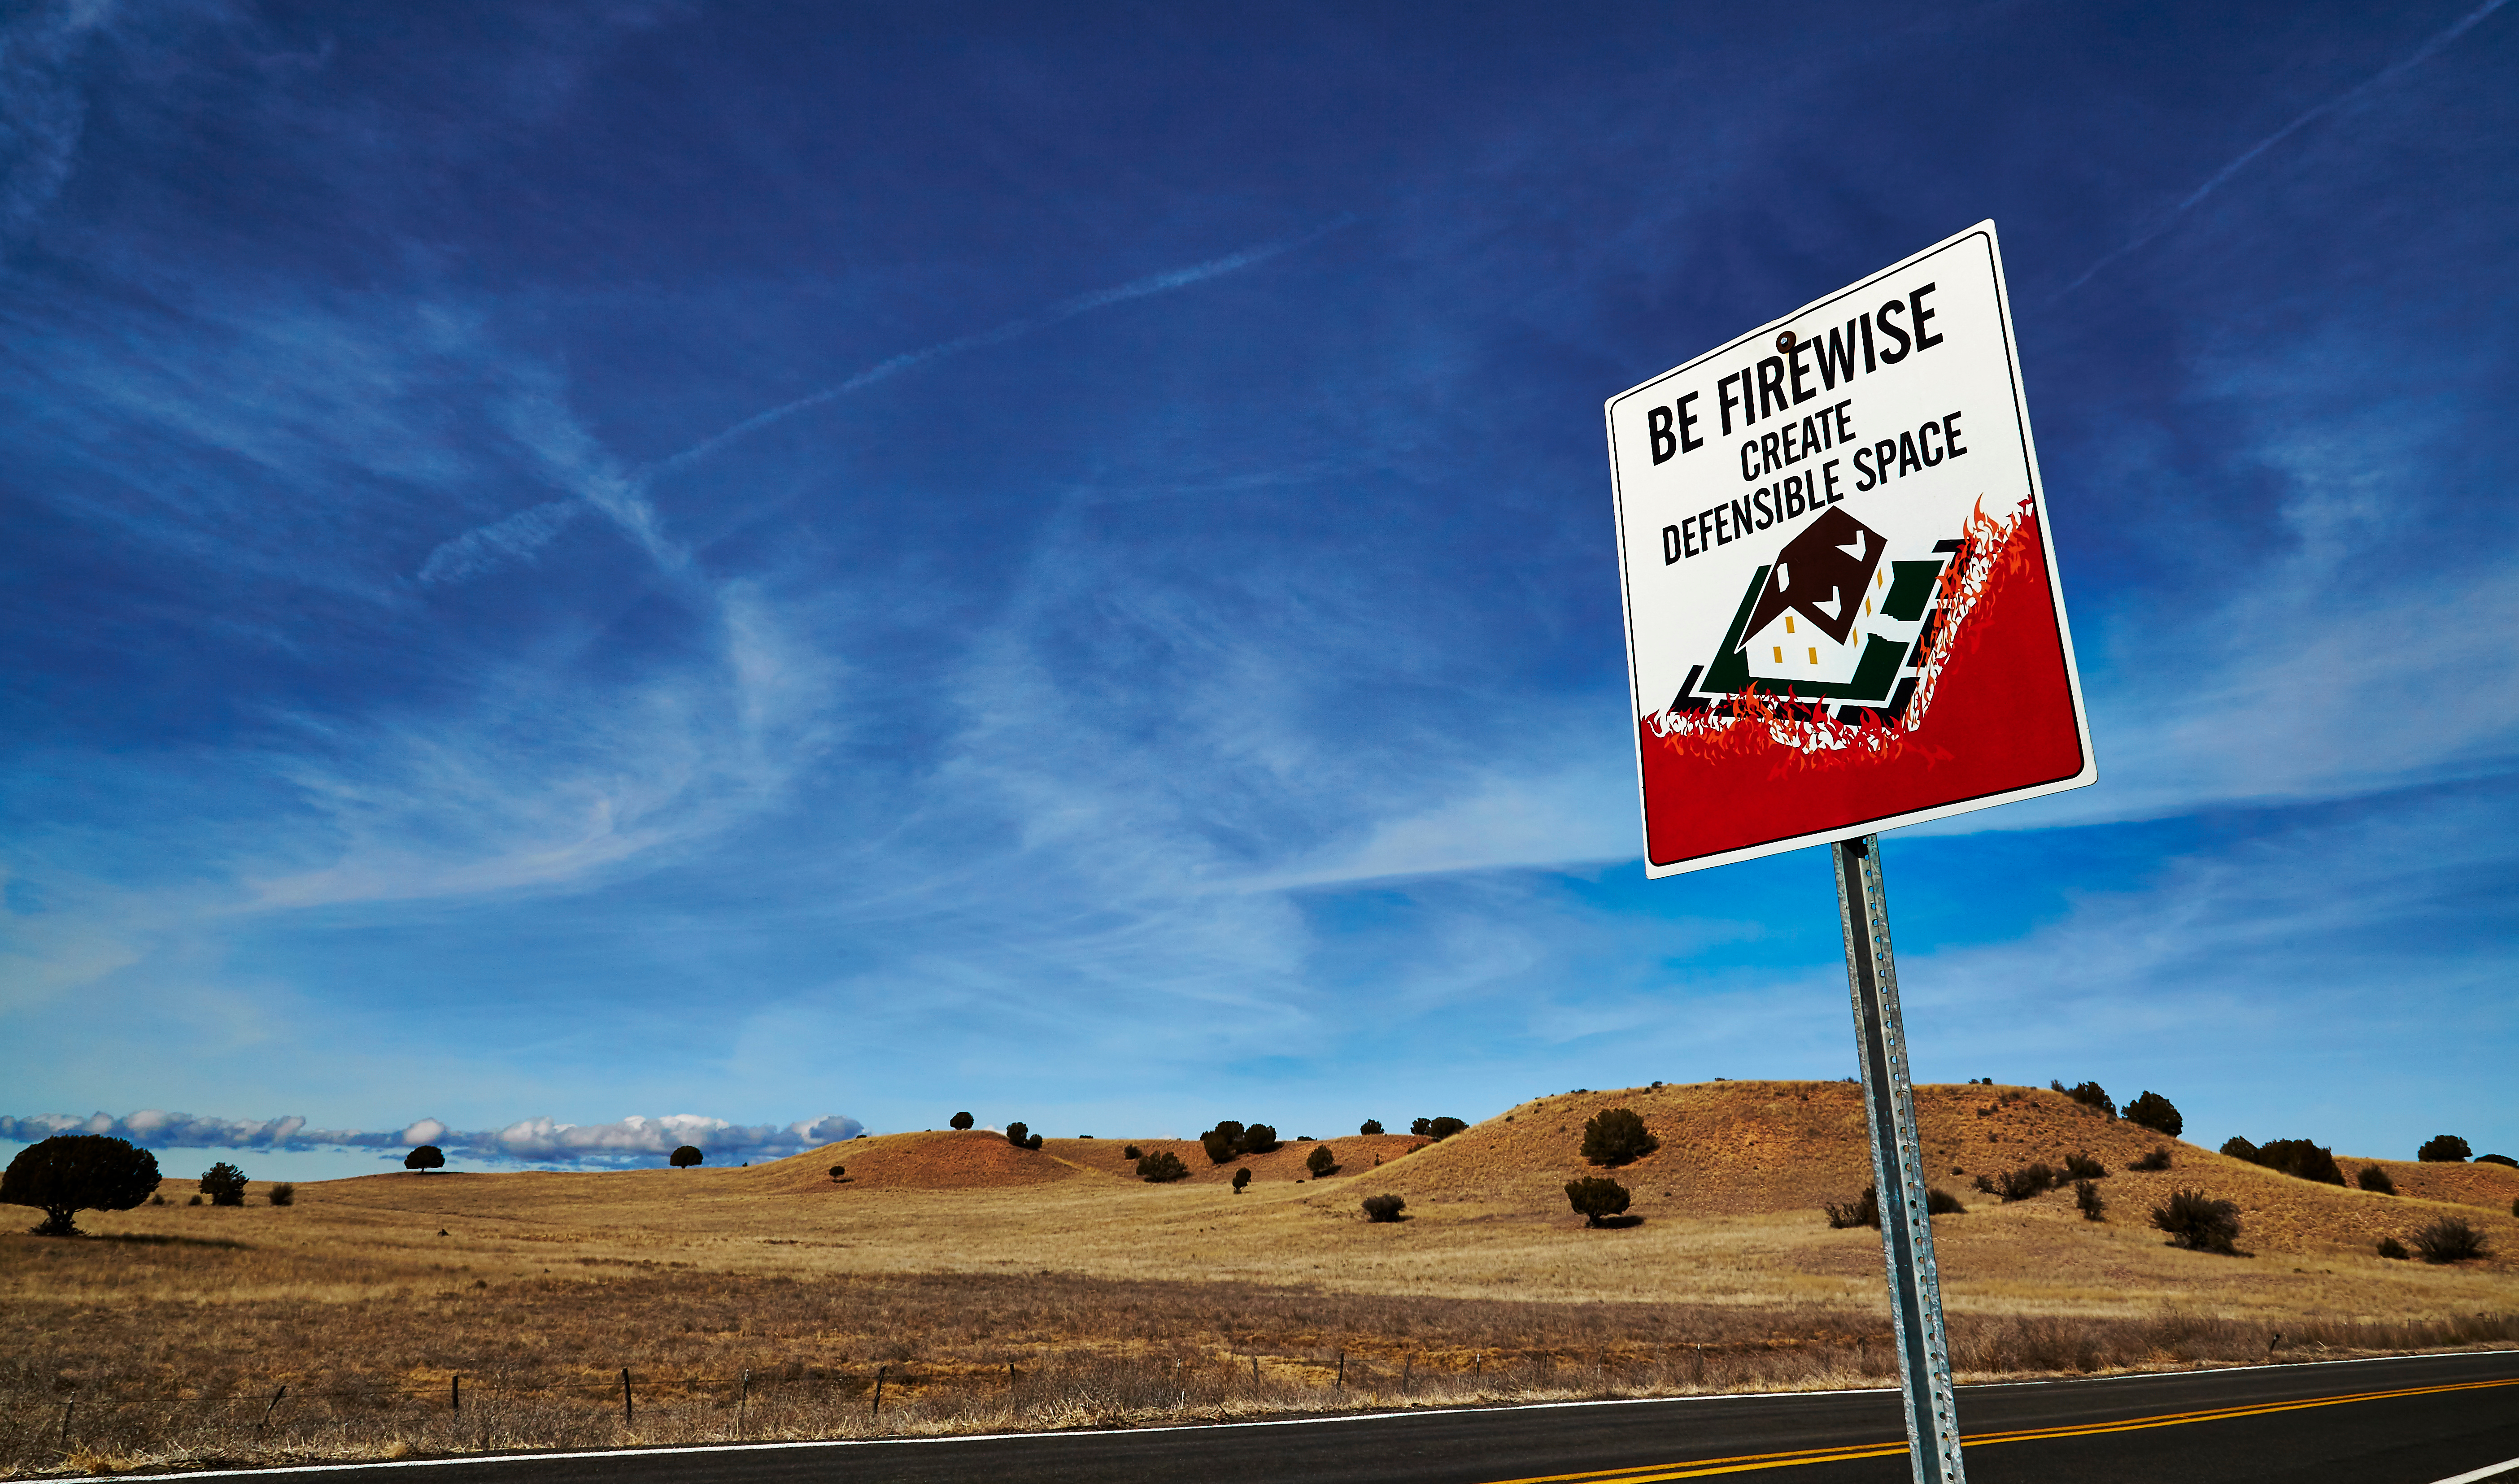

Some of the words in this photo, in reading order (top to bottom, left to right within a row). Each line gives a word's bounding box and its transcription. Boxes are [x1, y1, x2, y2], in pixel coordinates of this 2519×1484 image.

[1647, 390, 1704, 466] BE
[1717, 282, 1944, 437] FIREWISE
[1741, 398, 1856, 482] CREATE
[1662, 458, 1844, 566] DEFENSIBLE
[1853, 410, 1968, 492] SPACE
